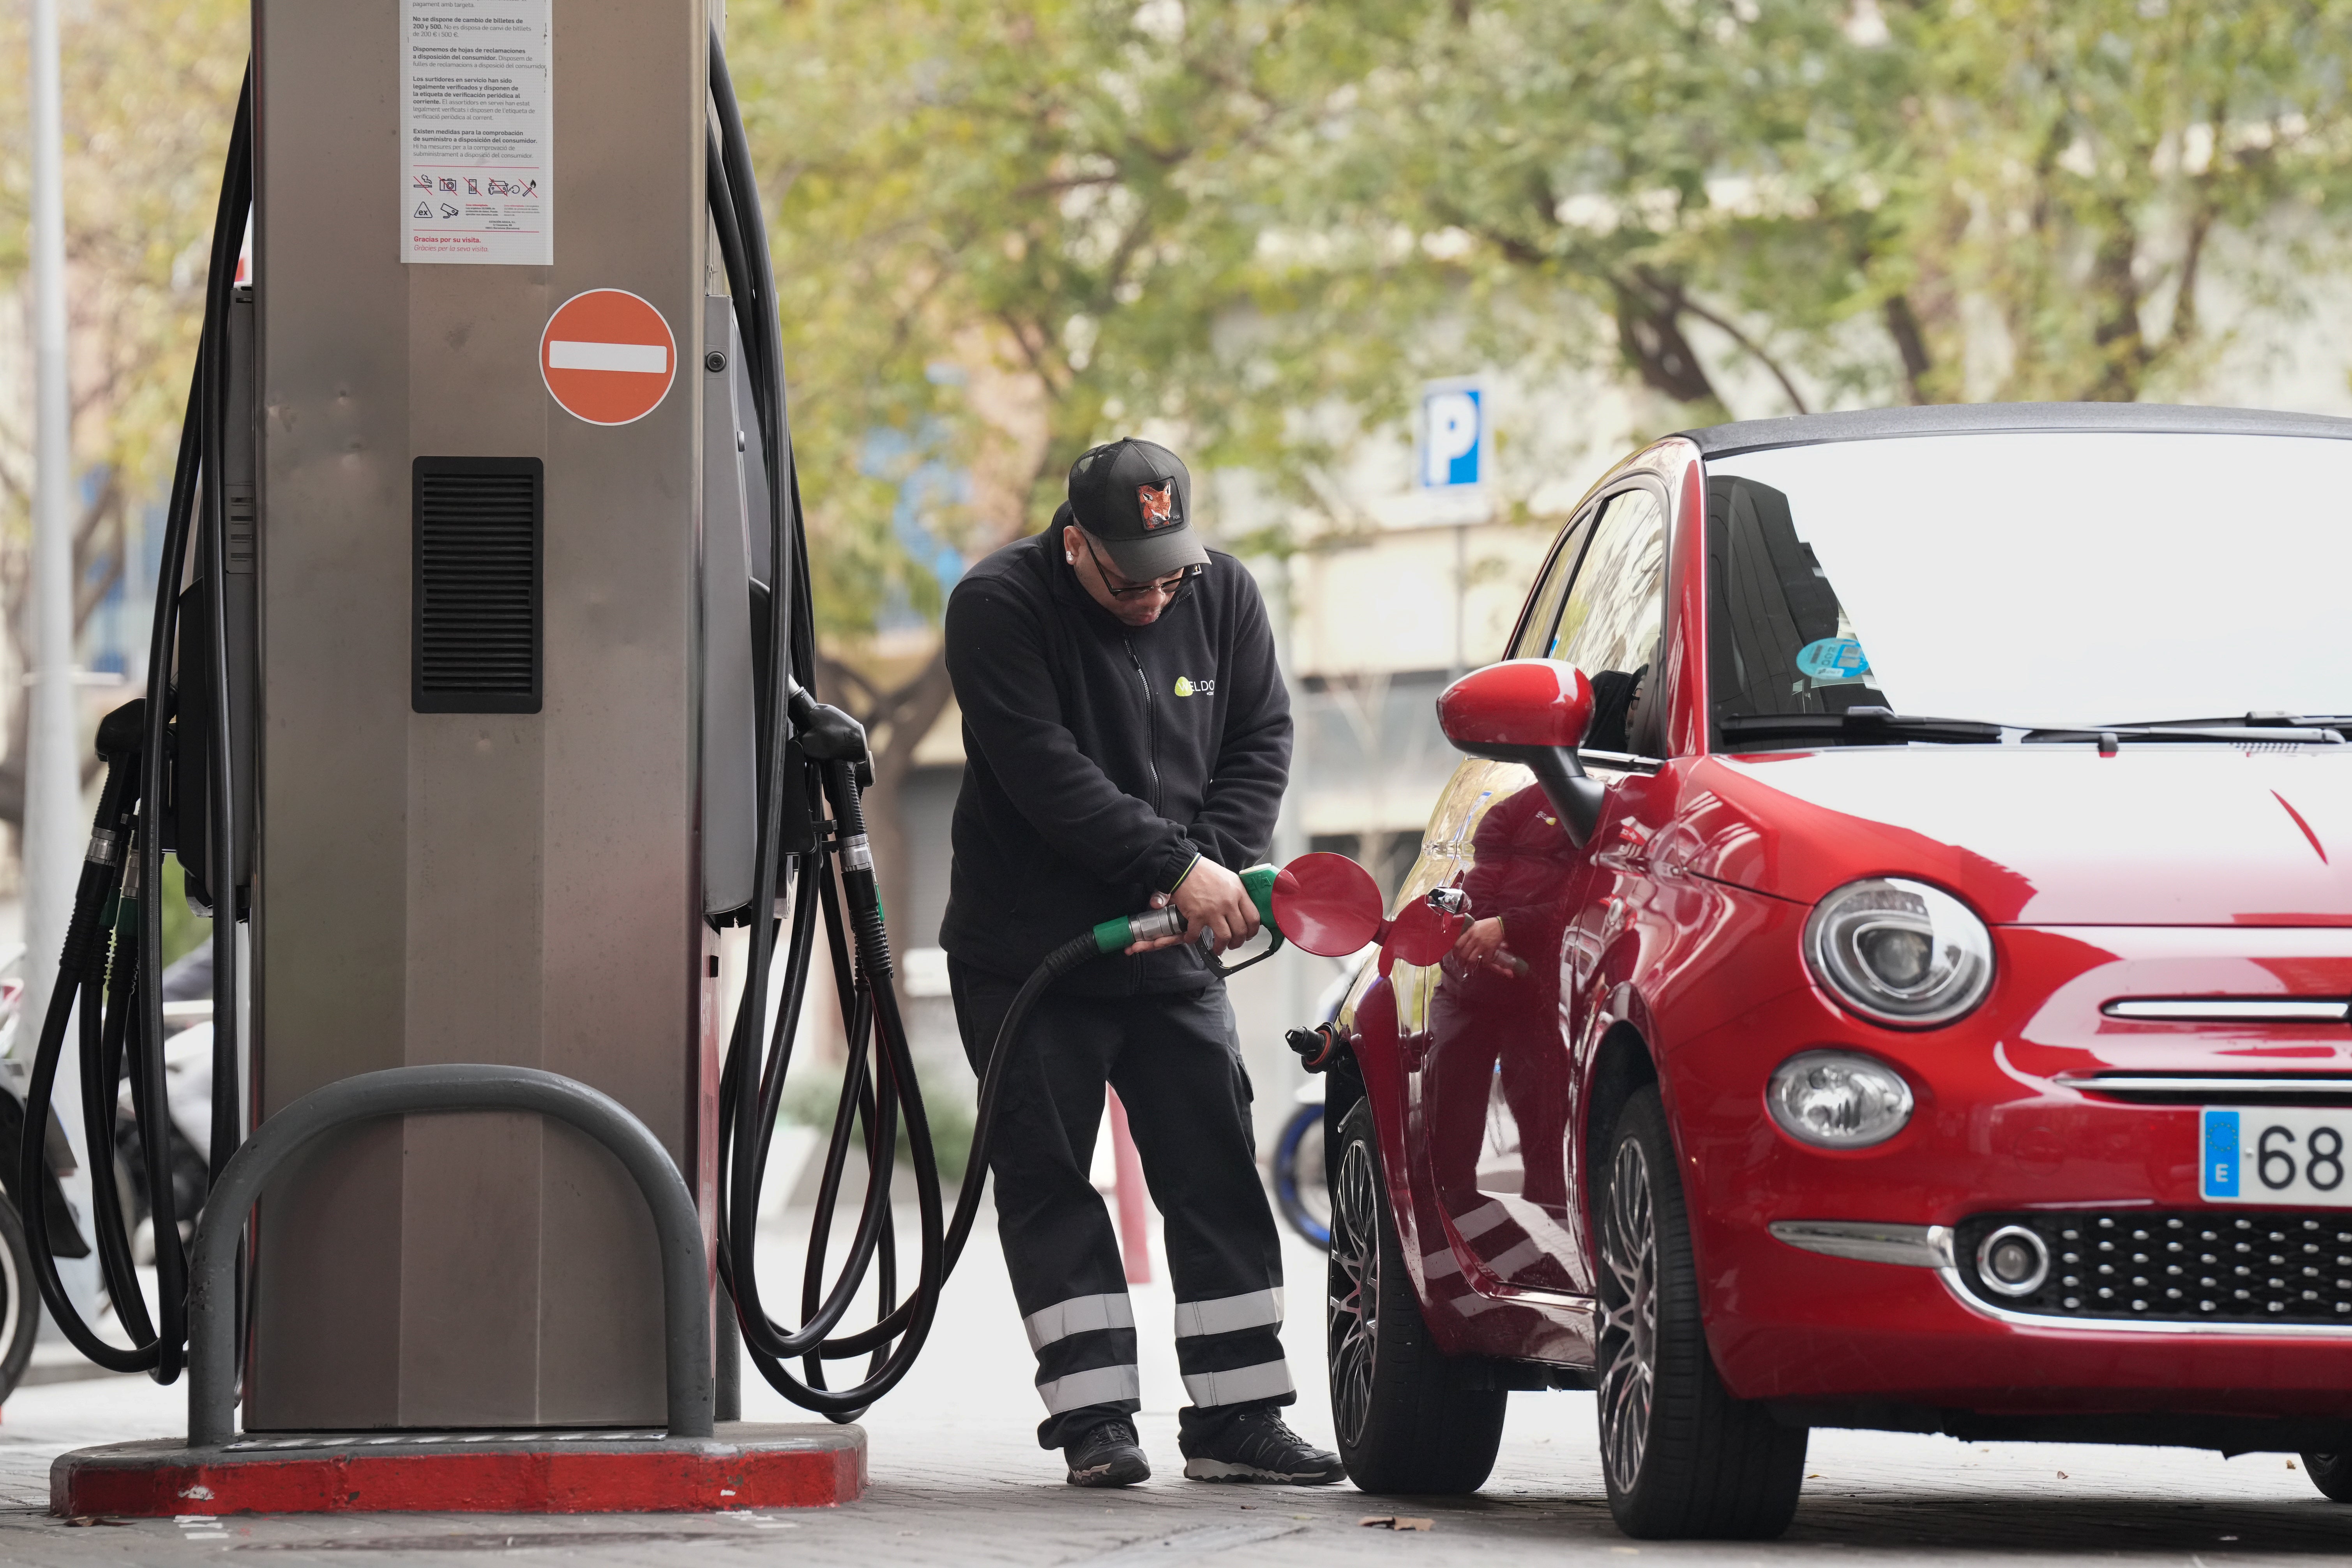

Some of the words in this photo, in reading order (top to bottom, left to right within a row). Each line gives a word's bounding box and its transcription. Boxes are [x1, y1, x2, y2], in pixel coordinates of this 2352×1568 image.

[1429, 395, 1478, 483] P
[1178, 680, 1215, 692] WELDO
[2215, 1163, 2229, 1183] E
[2257, 1125, 2344, 1192] 68
